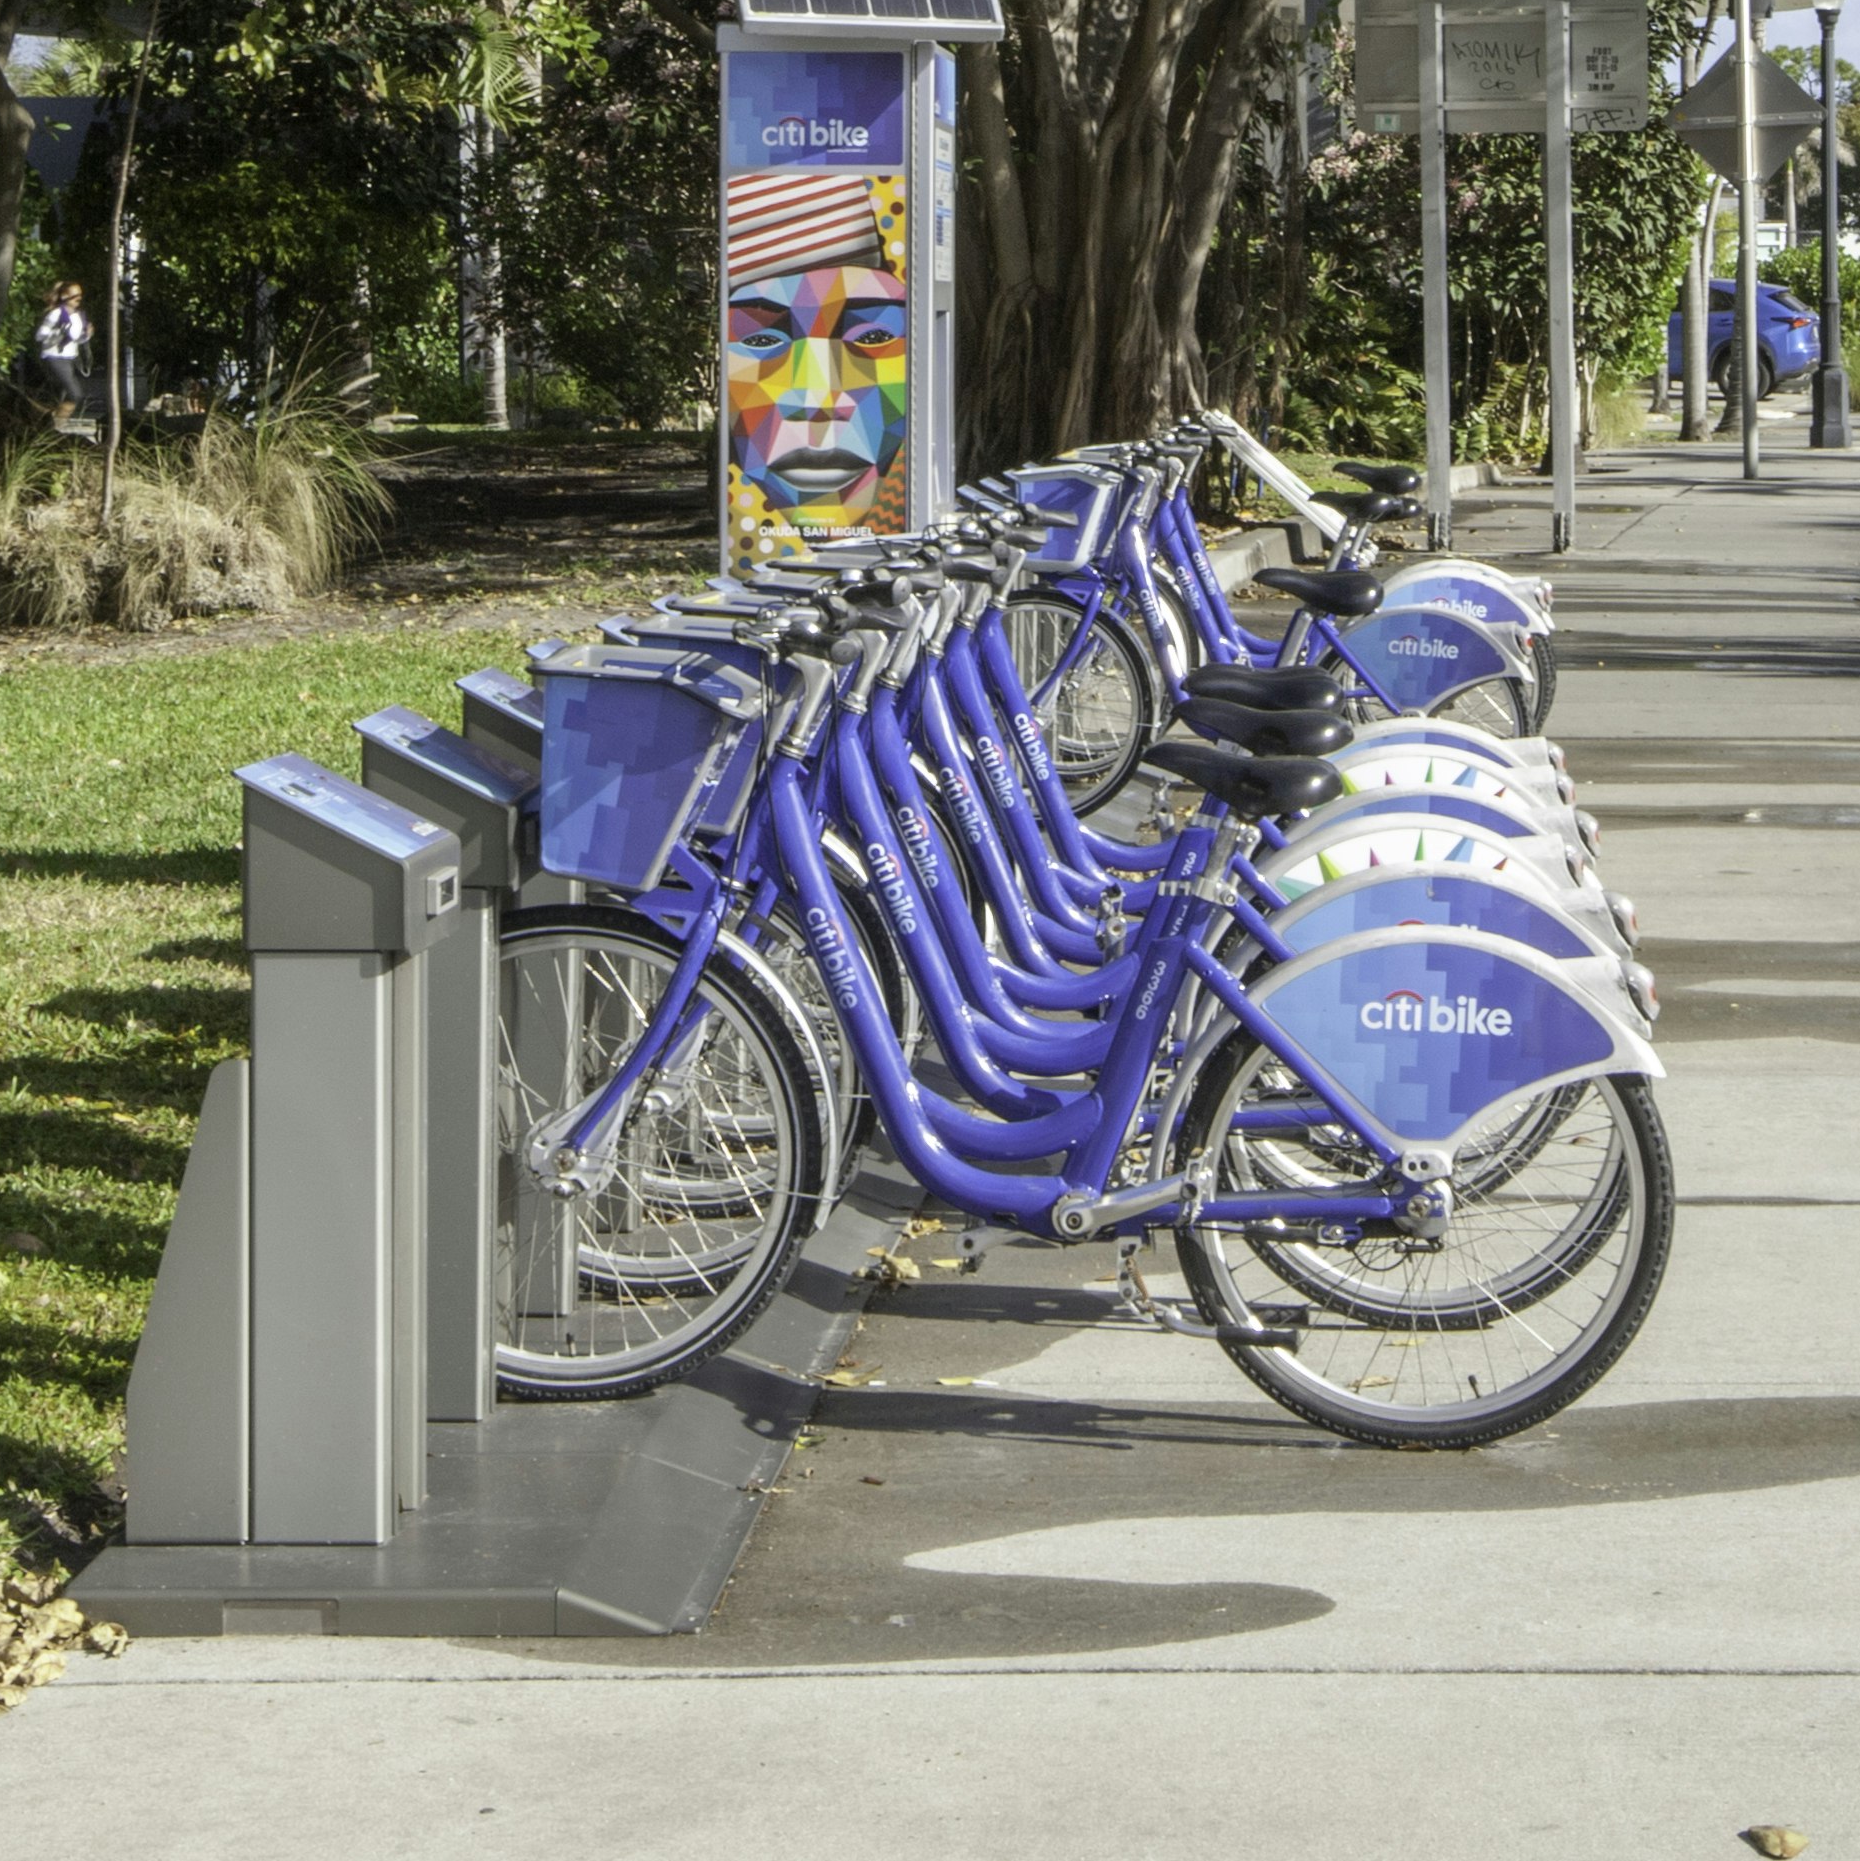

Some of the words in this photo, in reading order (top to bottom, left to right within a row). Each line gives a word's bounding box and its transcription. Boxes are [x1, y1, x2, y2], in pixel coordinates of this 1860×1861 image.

[1468, 60, 1516, 76] 2016
[761, 117, 806, 147] citi
[810, 119, 869, 147] bike
[759, 526, 800, 537] OKUDA
[803, 526, 828, 537] SAN
[830, 526, 874, 537] MIGUEL
[1388, 635, 1418, 656] citi
[1420, 638, 1459, 660] bike
[1014, 713, 1039, 743] citi
[977, 736, 1005, 768] citi
[1026, 741, 1050, 781] bike
[941, 767, 968, 801] citi
[990, 765, 1015, 809] bike
[897, 806, 929, 842] citi
[954, 798, 982, 845] bike
[867, 843, 902, 884] citi
[883, 879, 917, 936] bike
[807, 907, 844, 951] citi
[823, 948, 858, 1009] bike
[1360, 990, 1424, 1032] citi
[1429, 995, 1513, 1036] bike
